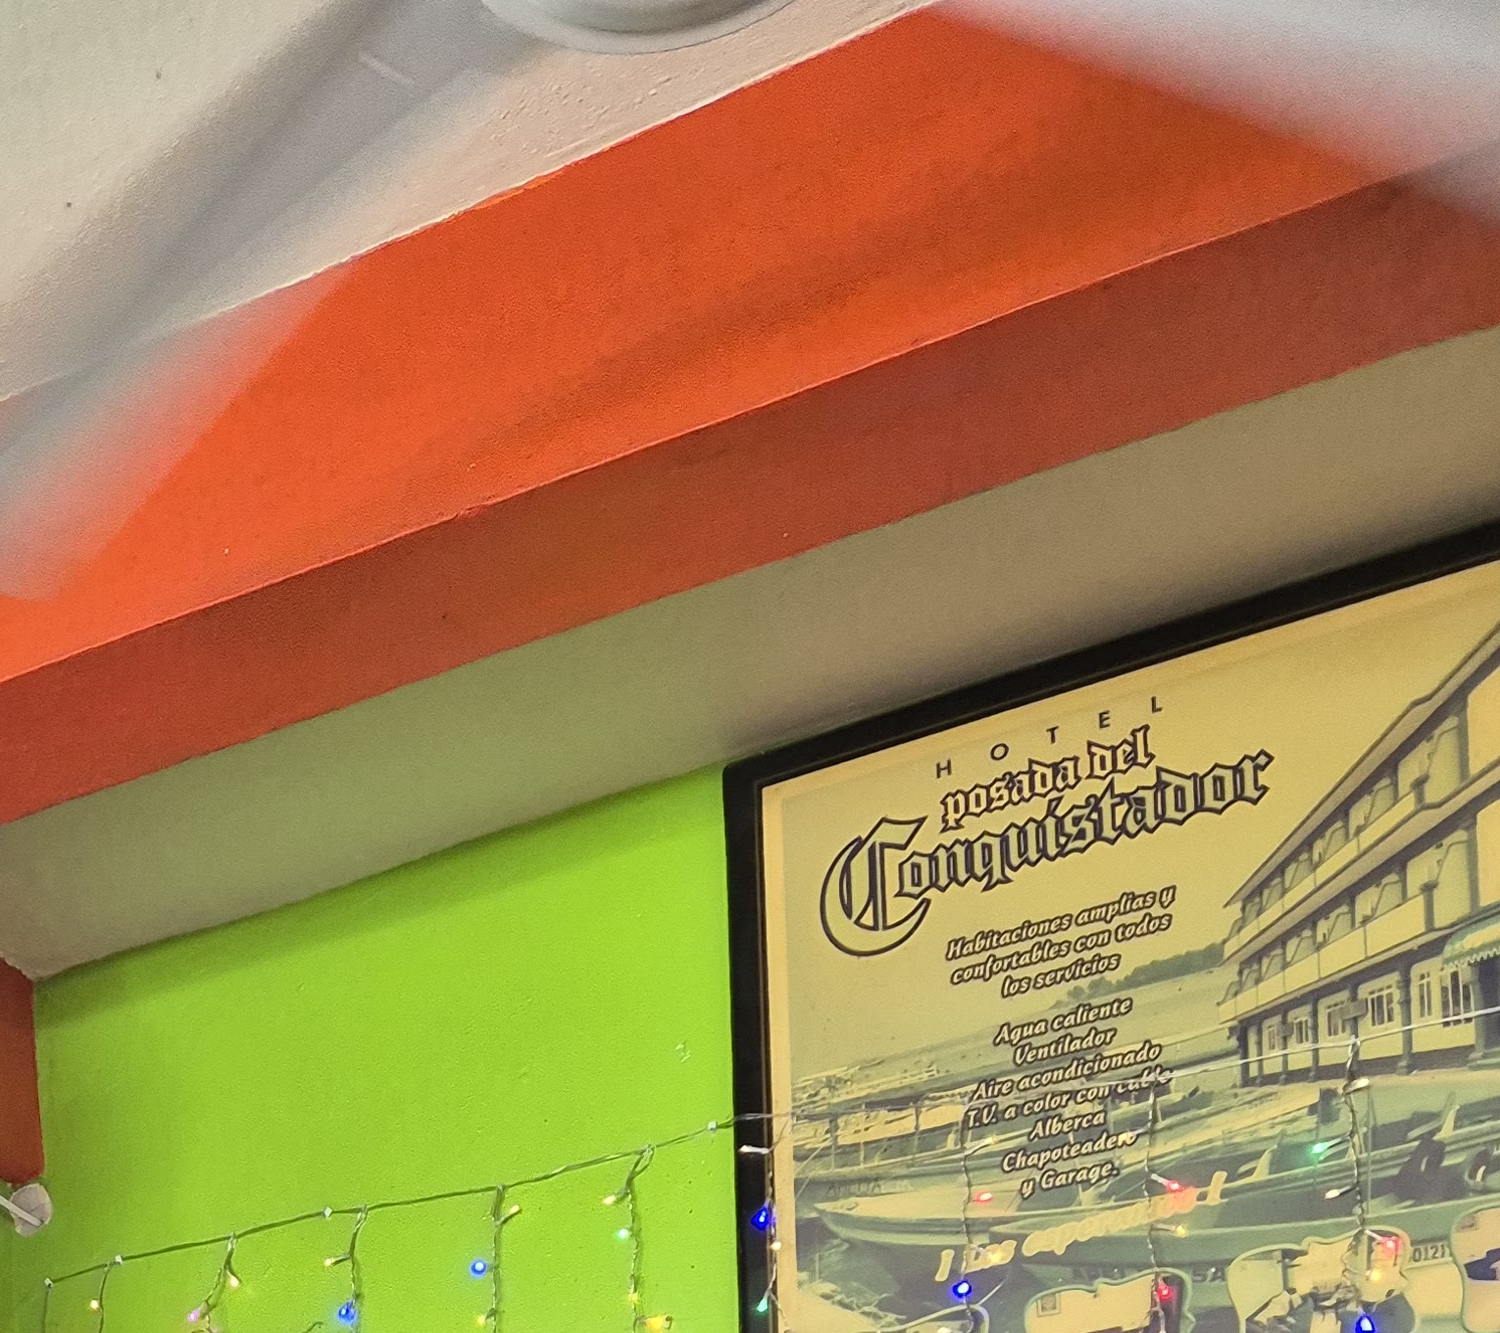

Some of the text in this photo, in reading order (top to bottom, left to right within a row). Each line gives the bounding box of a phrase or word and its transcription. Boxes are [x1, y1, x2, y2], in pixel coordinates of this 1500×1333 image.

[940, 724, 1155, 833] posada del
[820, 749, 1274, 957] Conquistador
[946, 885, 1177, 961] Habitaciones amplias y
[951, 913, 1173, 985] confortables con todos
[1001, 953, 1122, 999] los servicios
[994, 997, 1133, 1046] Agua caliente
[1013, 1026, 1117, 1066] Ventilador
[972, 1039, 1163, 1102] Aire acondicionado
[966, 1105, 998, 1130] T.V.
[1004, 1106, 1018, 1120] a
[1022, 1091, 1071, 1117] color
[1074, 1080, 1111, 1101] con
[1029, 1110, 1107, 1143] Alberca
[1020, 1160, 1120, 1199] y Garage.
